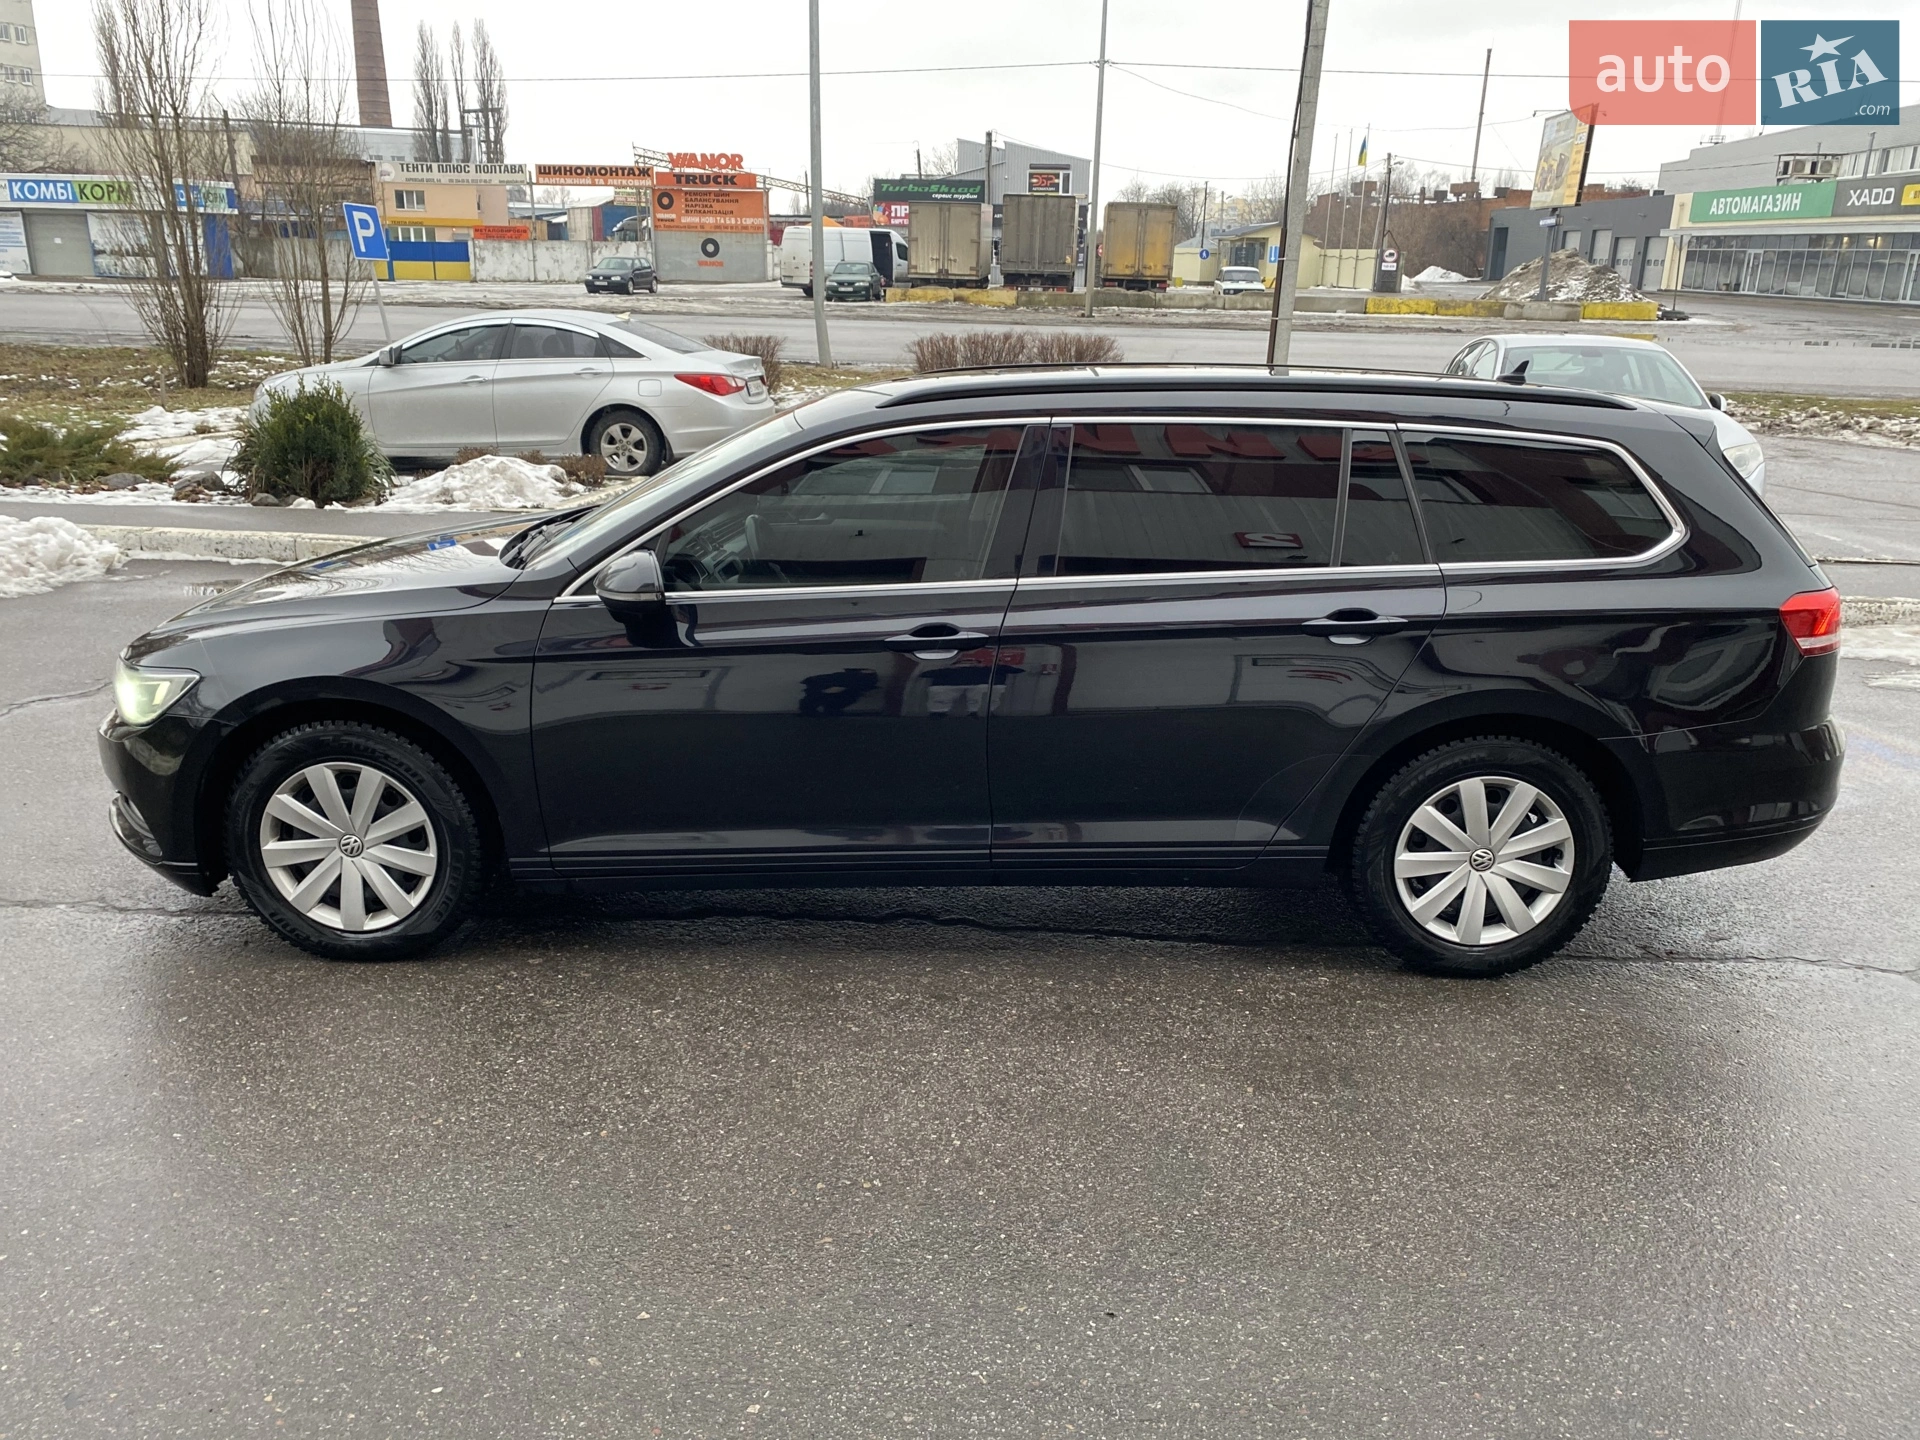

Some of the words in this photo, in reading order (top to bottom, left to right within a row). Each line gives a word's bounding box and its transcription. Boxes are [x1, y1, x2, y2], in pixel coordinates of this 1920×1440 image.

[399, 162, 433, 173] ТЕНТИ
[438, 164, 470, 174] ПЛЮС
[475, 164, 524, 175] ПОЛТАВА
[538, 165, 651, 177] ШИНОМОНТАЖ
[538, 177, 591, 185] ВАНТАЖНИЙ
[607, 178, 652, 186] ЛЕГКОВИЙ
[673, 174, 738, 185] TRUCK
[1846, 187, 1895, 206] XADO
[1709, 192, 1802, 215] АВТОМАГАЗИН
[352, 211, 376, 252] P
